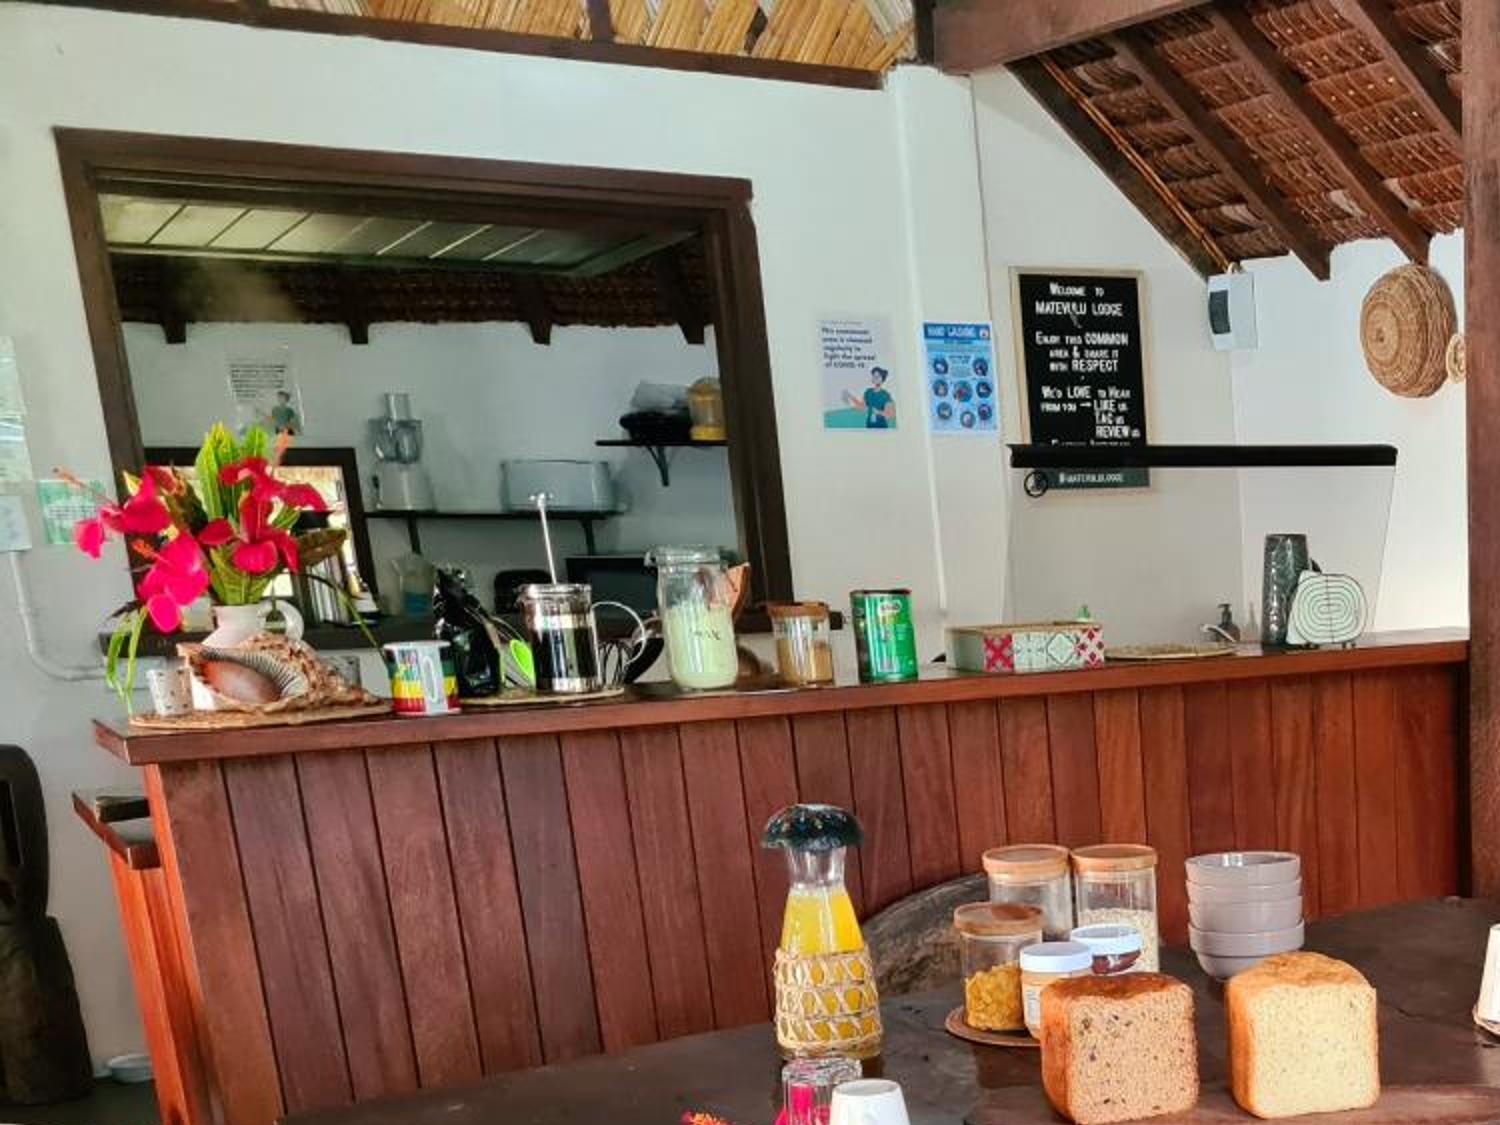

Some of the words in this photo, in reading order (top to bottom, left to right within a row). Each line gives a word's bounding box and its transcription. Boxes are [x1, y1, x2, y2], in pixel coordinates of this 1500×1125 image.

[1092, 302, 1123, 317] LODGE
[1084, 332, 1129, 346] COMMON
[1072, 359, 1119, 373] RESPECT
[1067, 385, 1092, 399] LOVE
[1095, 426, 1130, 438] REVIEW
